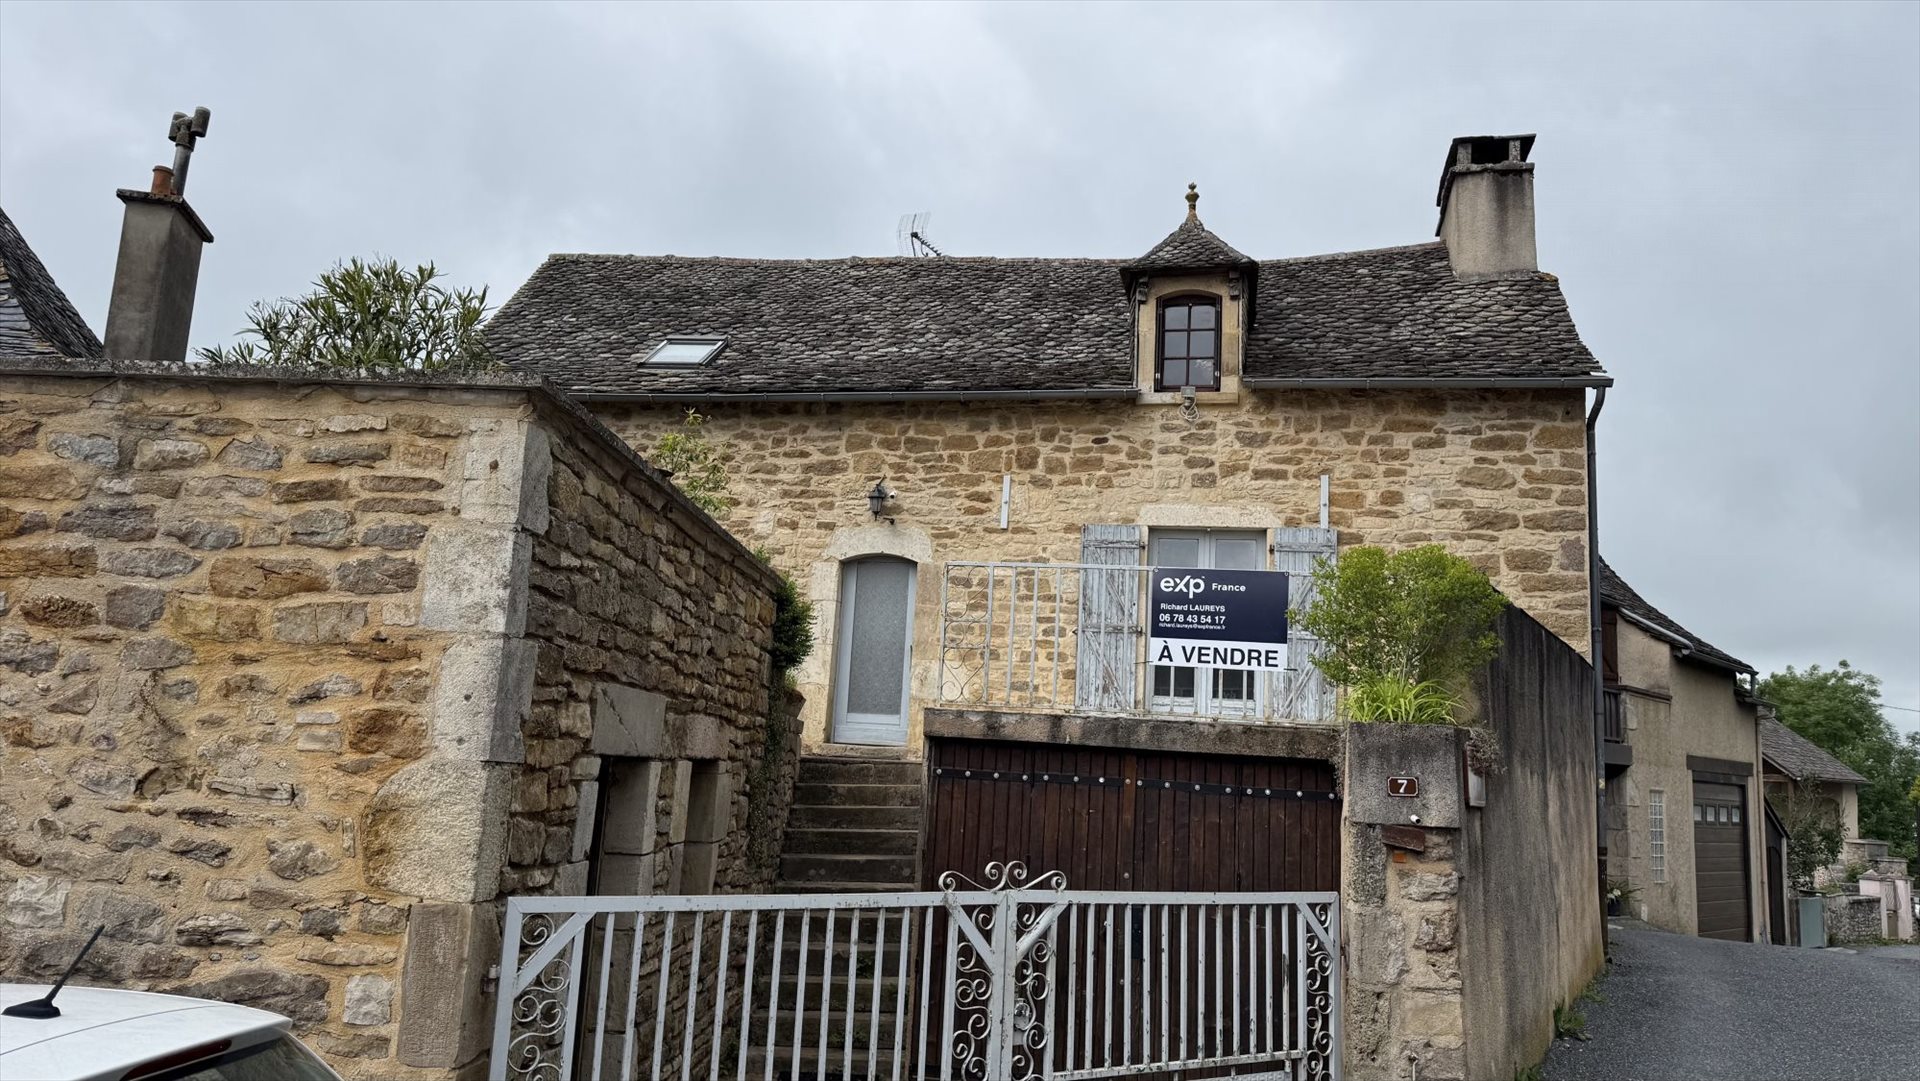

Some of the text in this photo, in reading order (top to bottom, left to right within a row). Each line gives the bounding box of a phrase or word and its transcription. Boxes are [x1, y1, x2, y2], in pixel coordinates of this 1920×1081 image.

[1160, 575, 1246, 599] exp France
[1160, 603, 1226, 612] Richard LAUREYS
[1159, 613, 1226, 624] 06 78 43 54 17
[1158, 640, 1279, 668] À VENDRE
[1397, 779, 1408, 793] 7
